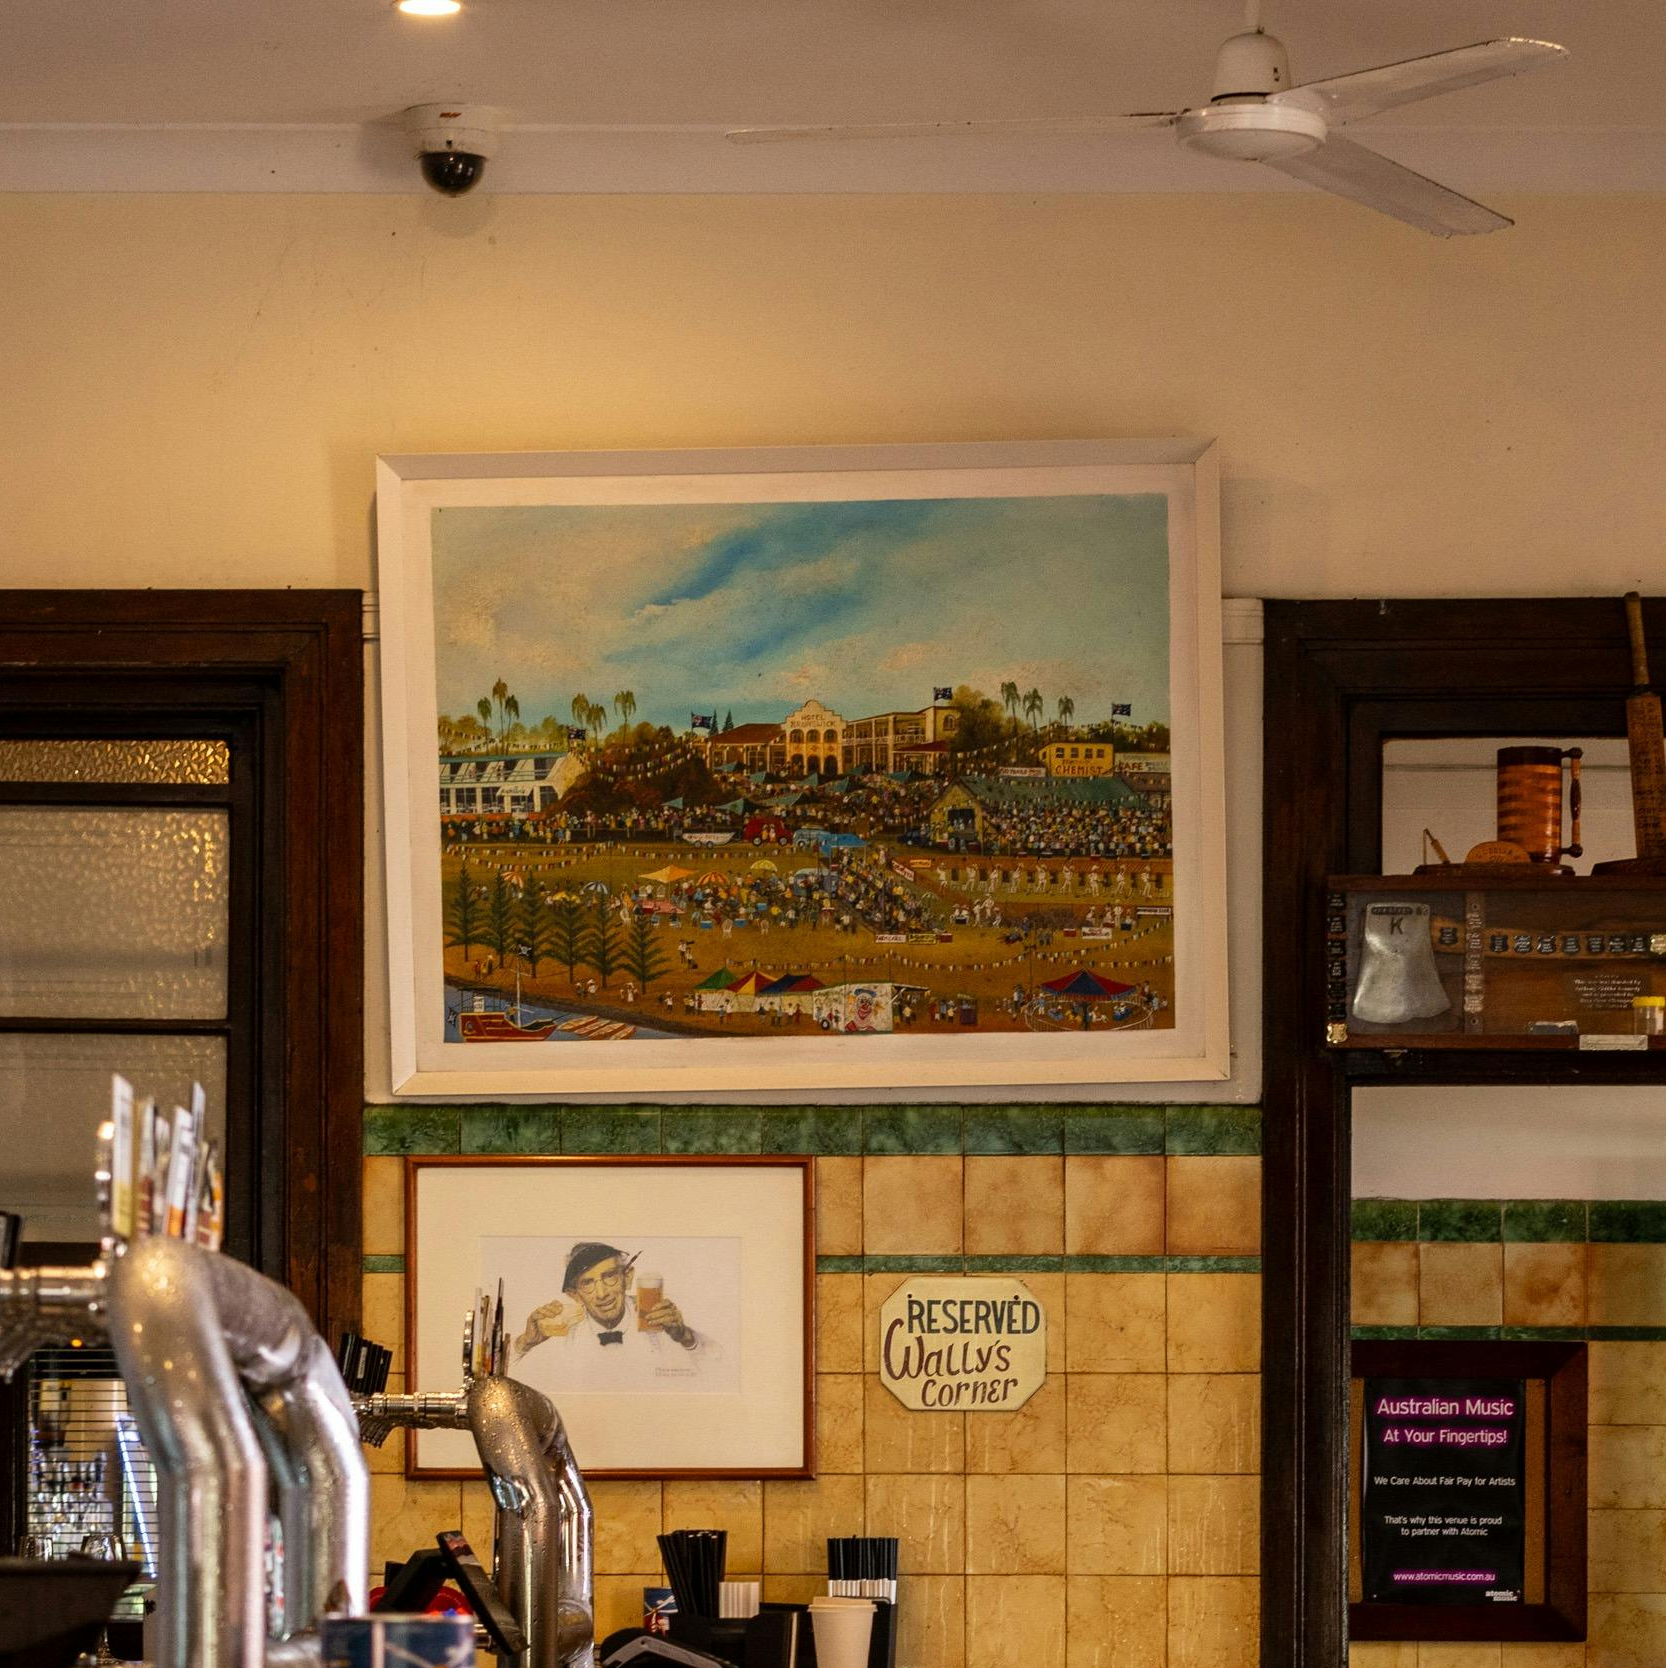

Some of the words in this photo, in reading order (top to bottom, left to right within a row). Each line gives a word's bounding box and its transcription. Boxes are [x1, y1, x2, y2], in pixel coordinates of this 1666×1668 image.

[1055, 765, 1104, 776] CHEMIST
[1390, 916, 1404, 935] K
[907, 1298, 1041, 1334] RESERVED
[883, 1318, 1012, 1381] Wally's
[1376, 1397, 1460, 1417] Australian
[1465, 1398, 1515, 1417] Music
[1383, 1428, 1400, 1443] At
[1404, 1428, 1435, 1443] Your
[1439, 1427, 1507, 1448] Fingertips!
[1374, 1476, 1388, 1486] We
[1390, 1476, 1410, 1486] Care
[1412, 1476, 1437, 1486] About
[1439, 1476, 1454, 1486] Fair
[1456, 1476, 1473, 1488] Pay
[1474, 1476, 1486, 1486] for
[1488, 1476, 1516, 1486] Artists
[1384, 1515, 1408, 1525] That's
[1409, 1515, 1426, 1528] why
[1428, 1515, 1442, 1525] this
[1444, 1516, 1468, 1525] venue
[1470, 1515, 1478, 1525] is
[1479, 1515, 1502, 1528] proud
[1400, 1527, 1409, 1536] to
[1411, 1527, 1440, 1538] partner
[1441, 1527, 1459, 1536] with
[1460, 1527, 1488, 1536] Atomic
[1393, 1571, 1496, 1582] www.atomicmusic.com.au
